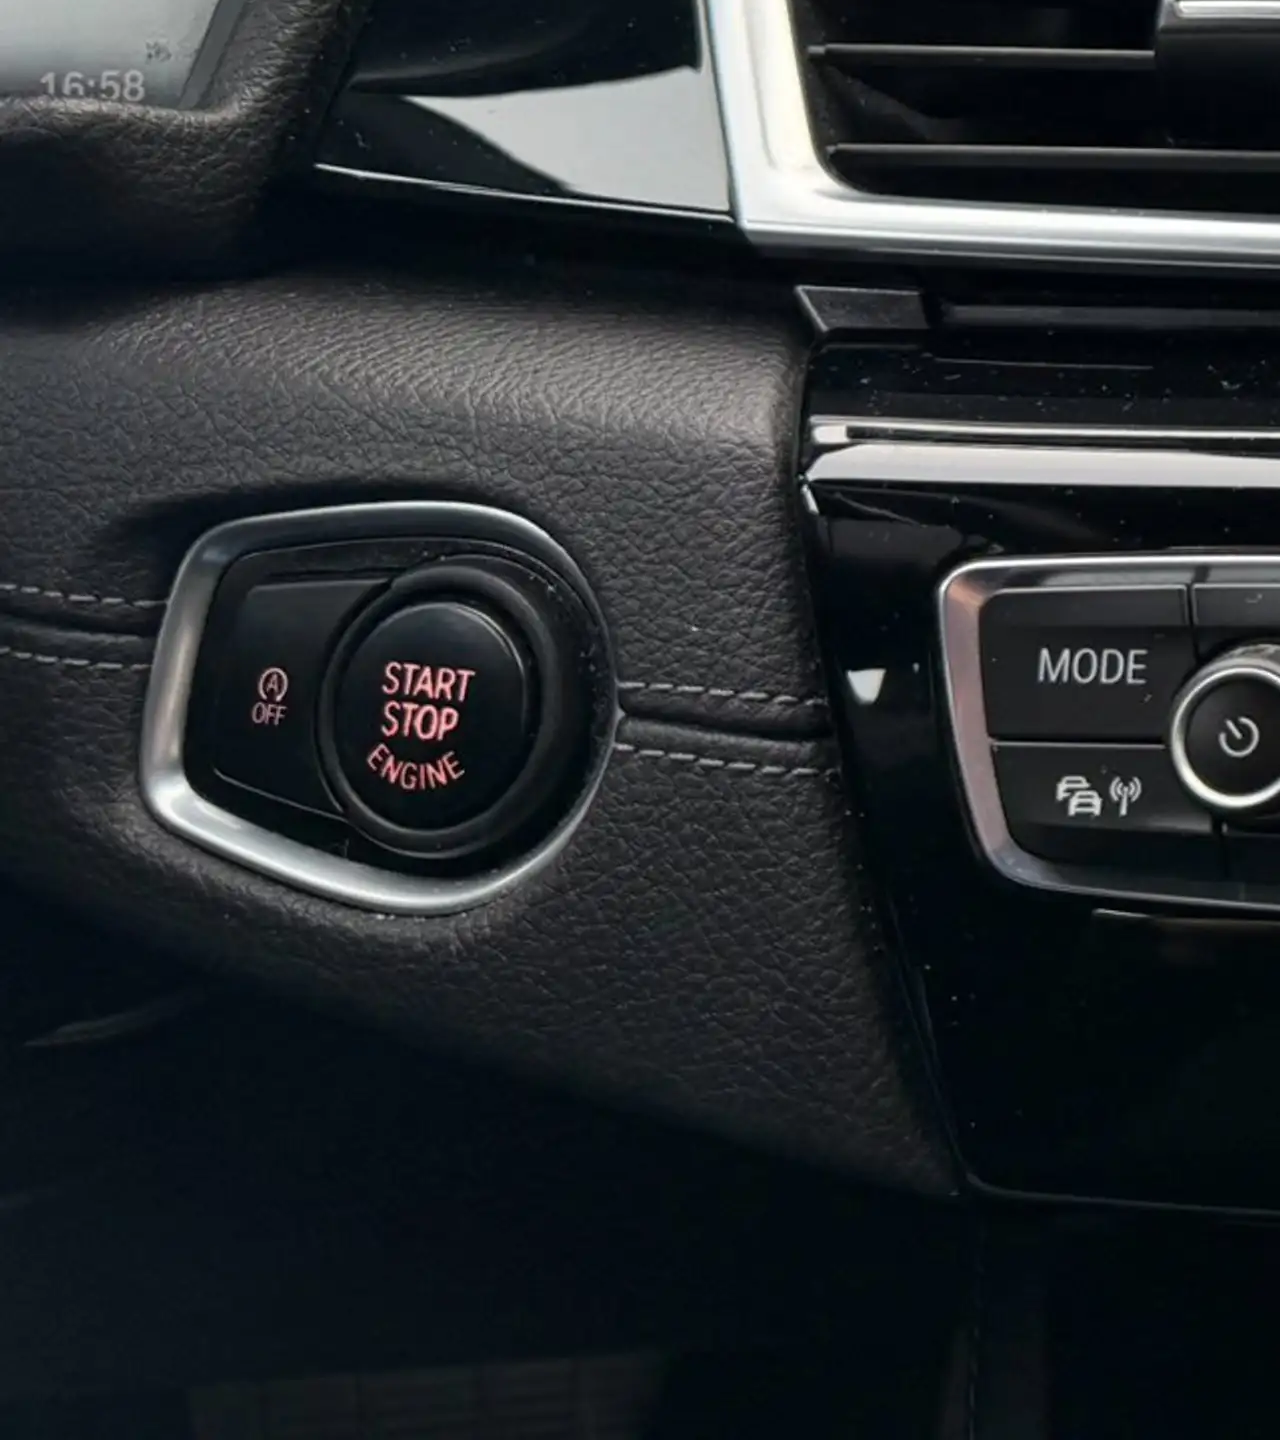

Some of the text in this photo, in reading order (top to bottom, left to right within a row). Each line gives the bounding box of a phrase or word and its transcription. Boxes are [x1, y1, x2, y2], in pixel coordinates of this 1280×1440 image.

[39, 68, 146, 103] 16:58
[382, 661, 475, 702] START
[1038, 648, 1147, 684] MODE
[252, 702, 288, 726] OFF
[380, 700, 460, 741] STOP
[366, 743, 466, 790] ENGINE
